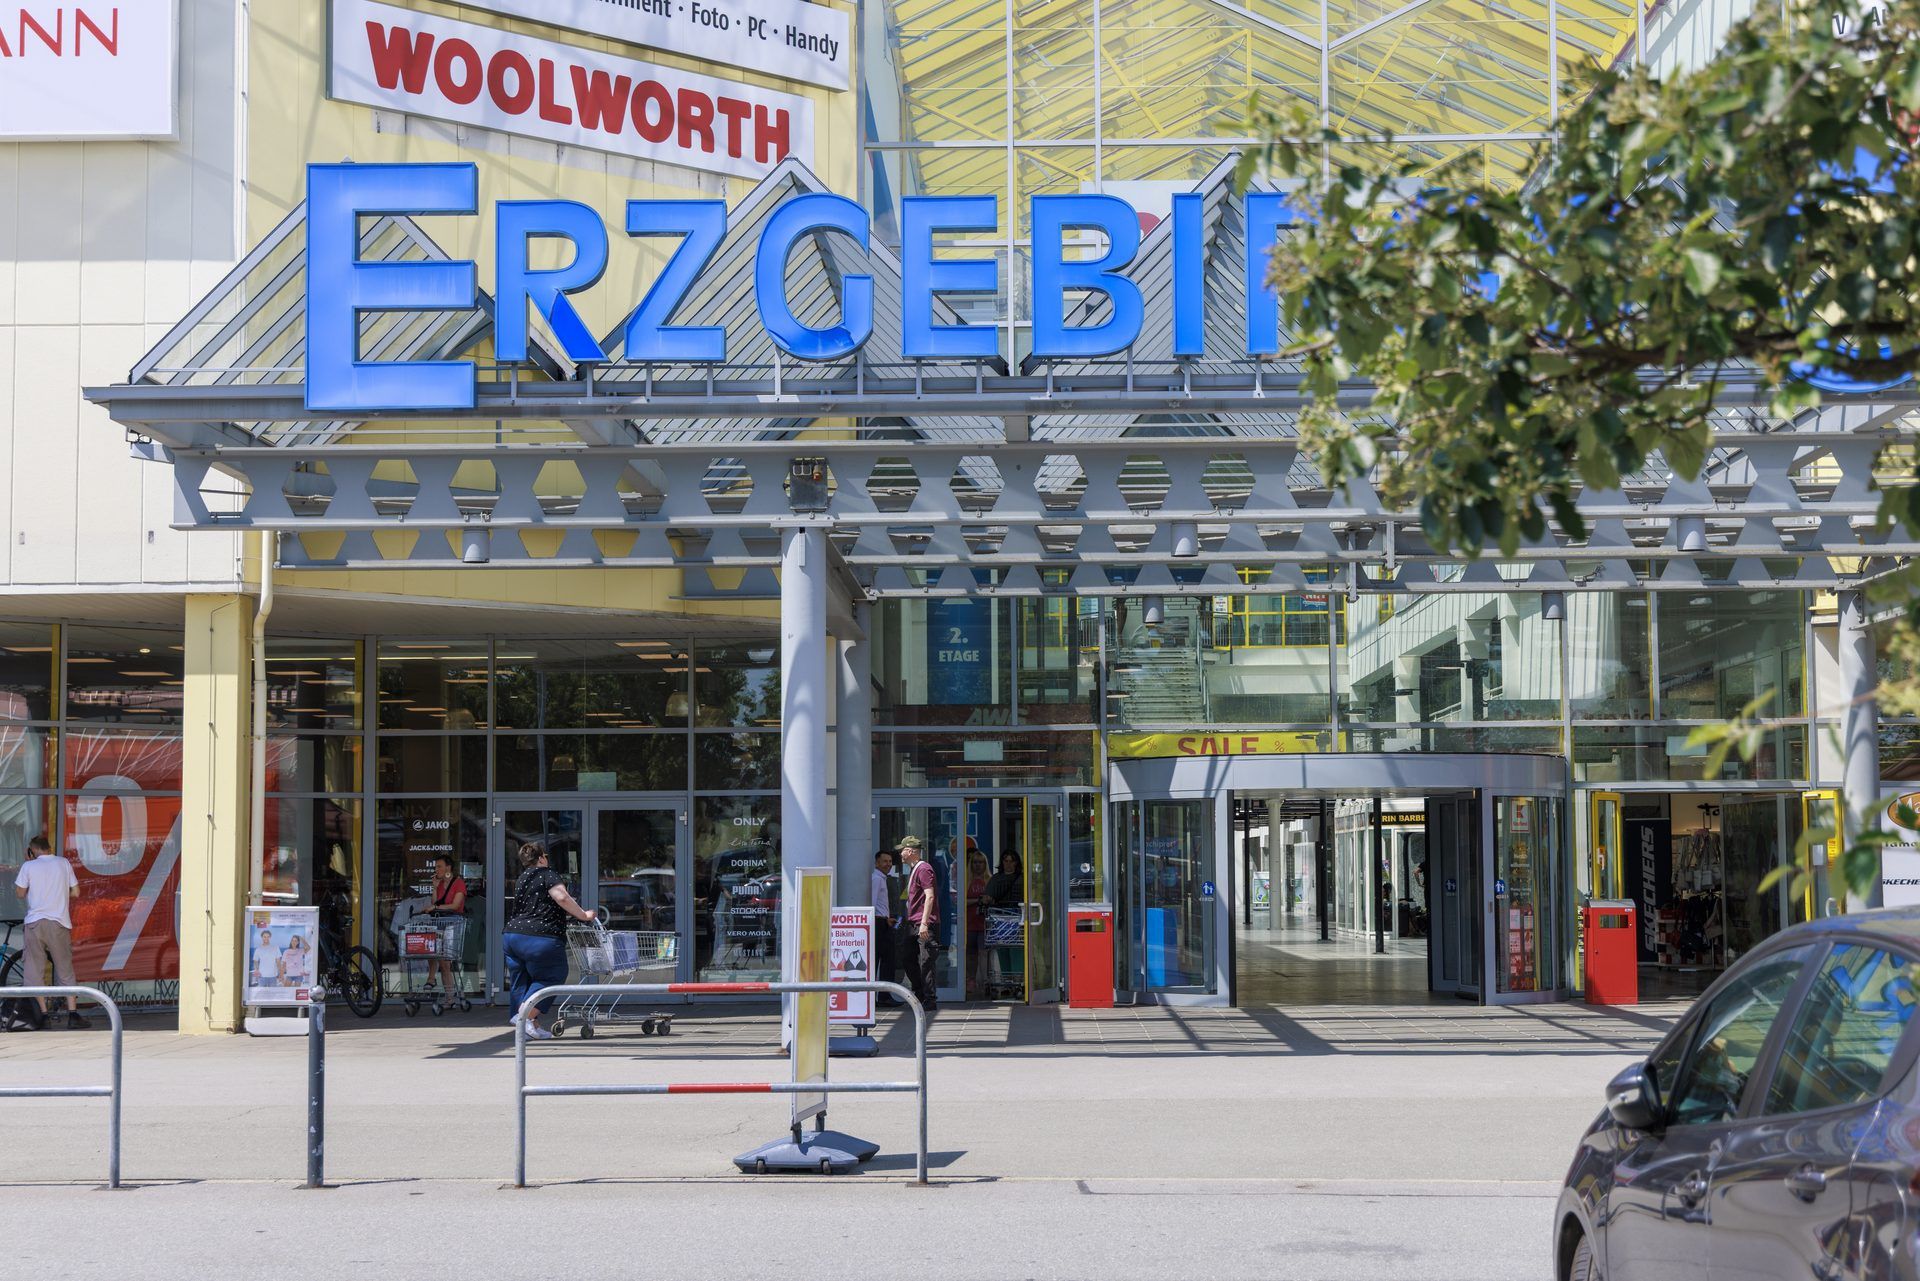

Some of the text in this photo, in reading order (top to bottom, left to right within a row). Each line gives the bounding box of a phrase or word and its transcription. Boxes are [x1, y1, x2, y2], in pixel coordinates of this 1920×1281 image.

[0, 8, 118, 57] NN
[692, 2, 729, 30] Foto
[748, 16, 767, 40] PC
[785, 25, 839, 61] Handy
[366, 20, 790, 164] WOOLWORTH
[949, 627, 969, 644] 2.
[938, 650, 980, 662] ETAGE
[425, 820, 450, 830] JAKO
[733, 817, 767, 826] ONLY
[731, 859, 766, 867] DORINA
[732, 885, 760, 895] PUMA
[1641, 825, 1656, 952] SKECHERS
[835, 930, 855, 938] Bikini
[836, 939, 865, 947] Unterteil
